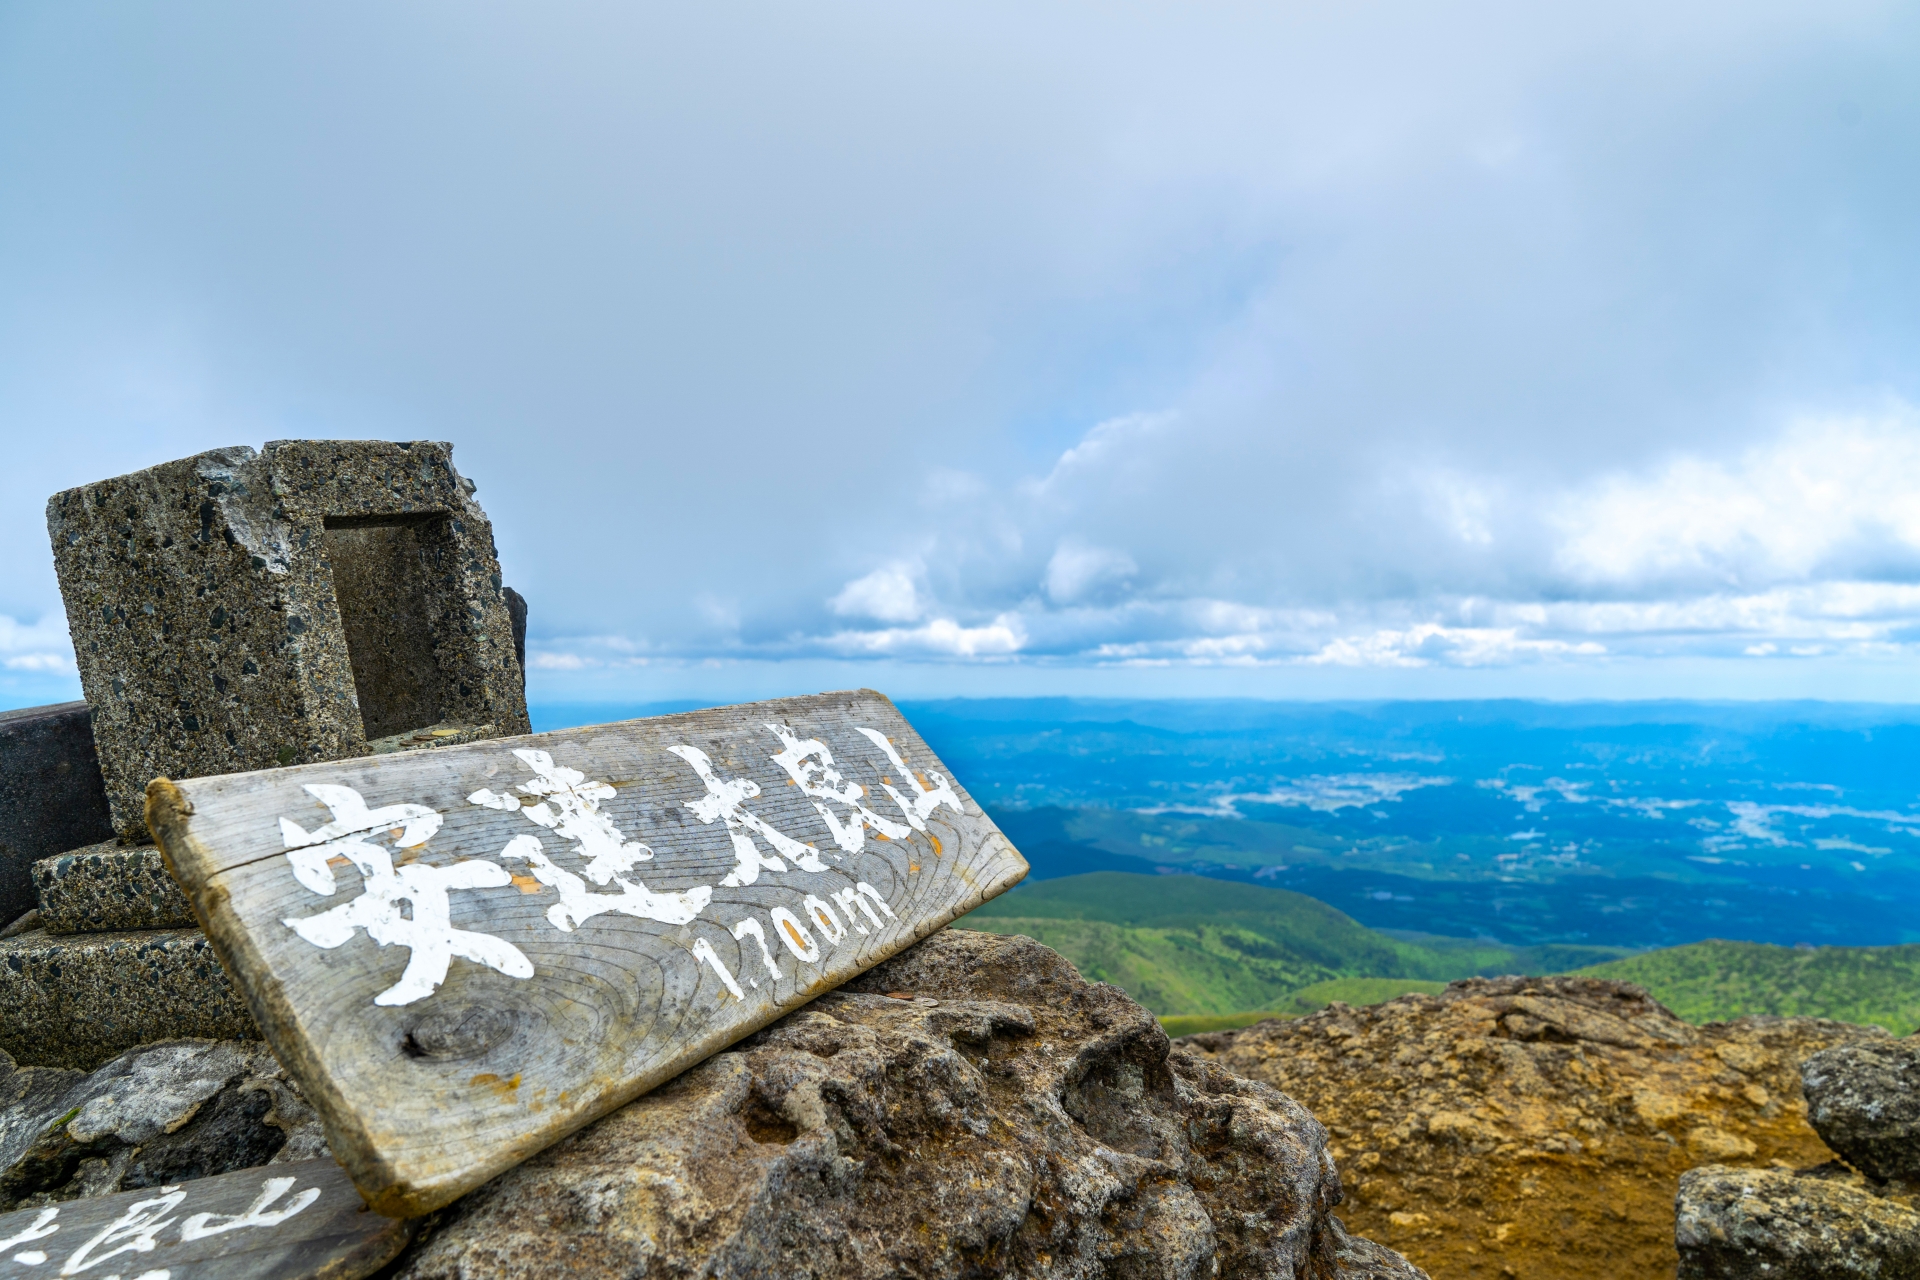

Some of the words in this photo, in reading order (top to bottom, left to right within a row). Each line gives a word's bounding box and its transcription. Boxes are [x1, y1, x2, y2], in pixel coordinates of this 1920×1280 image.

[279, 723, 964, 1006] 安達太良山
